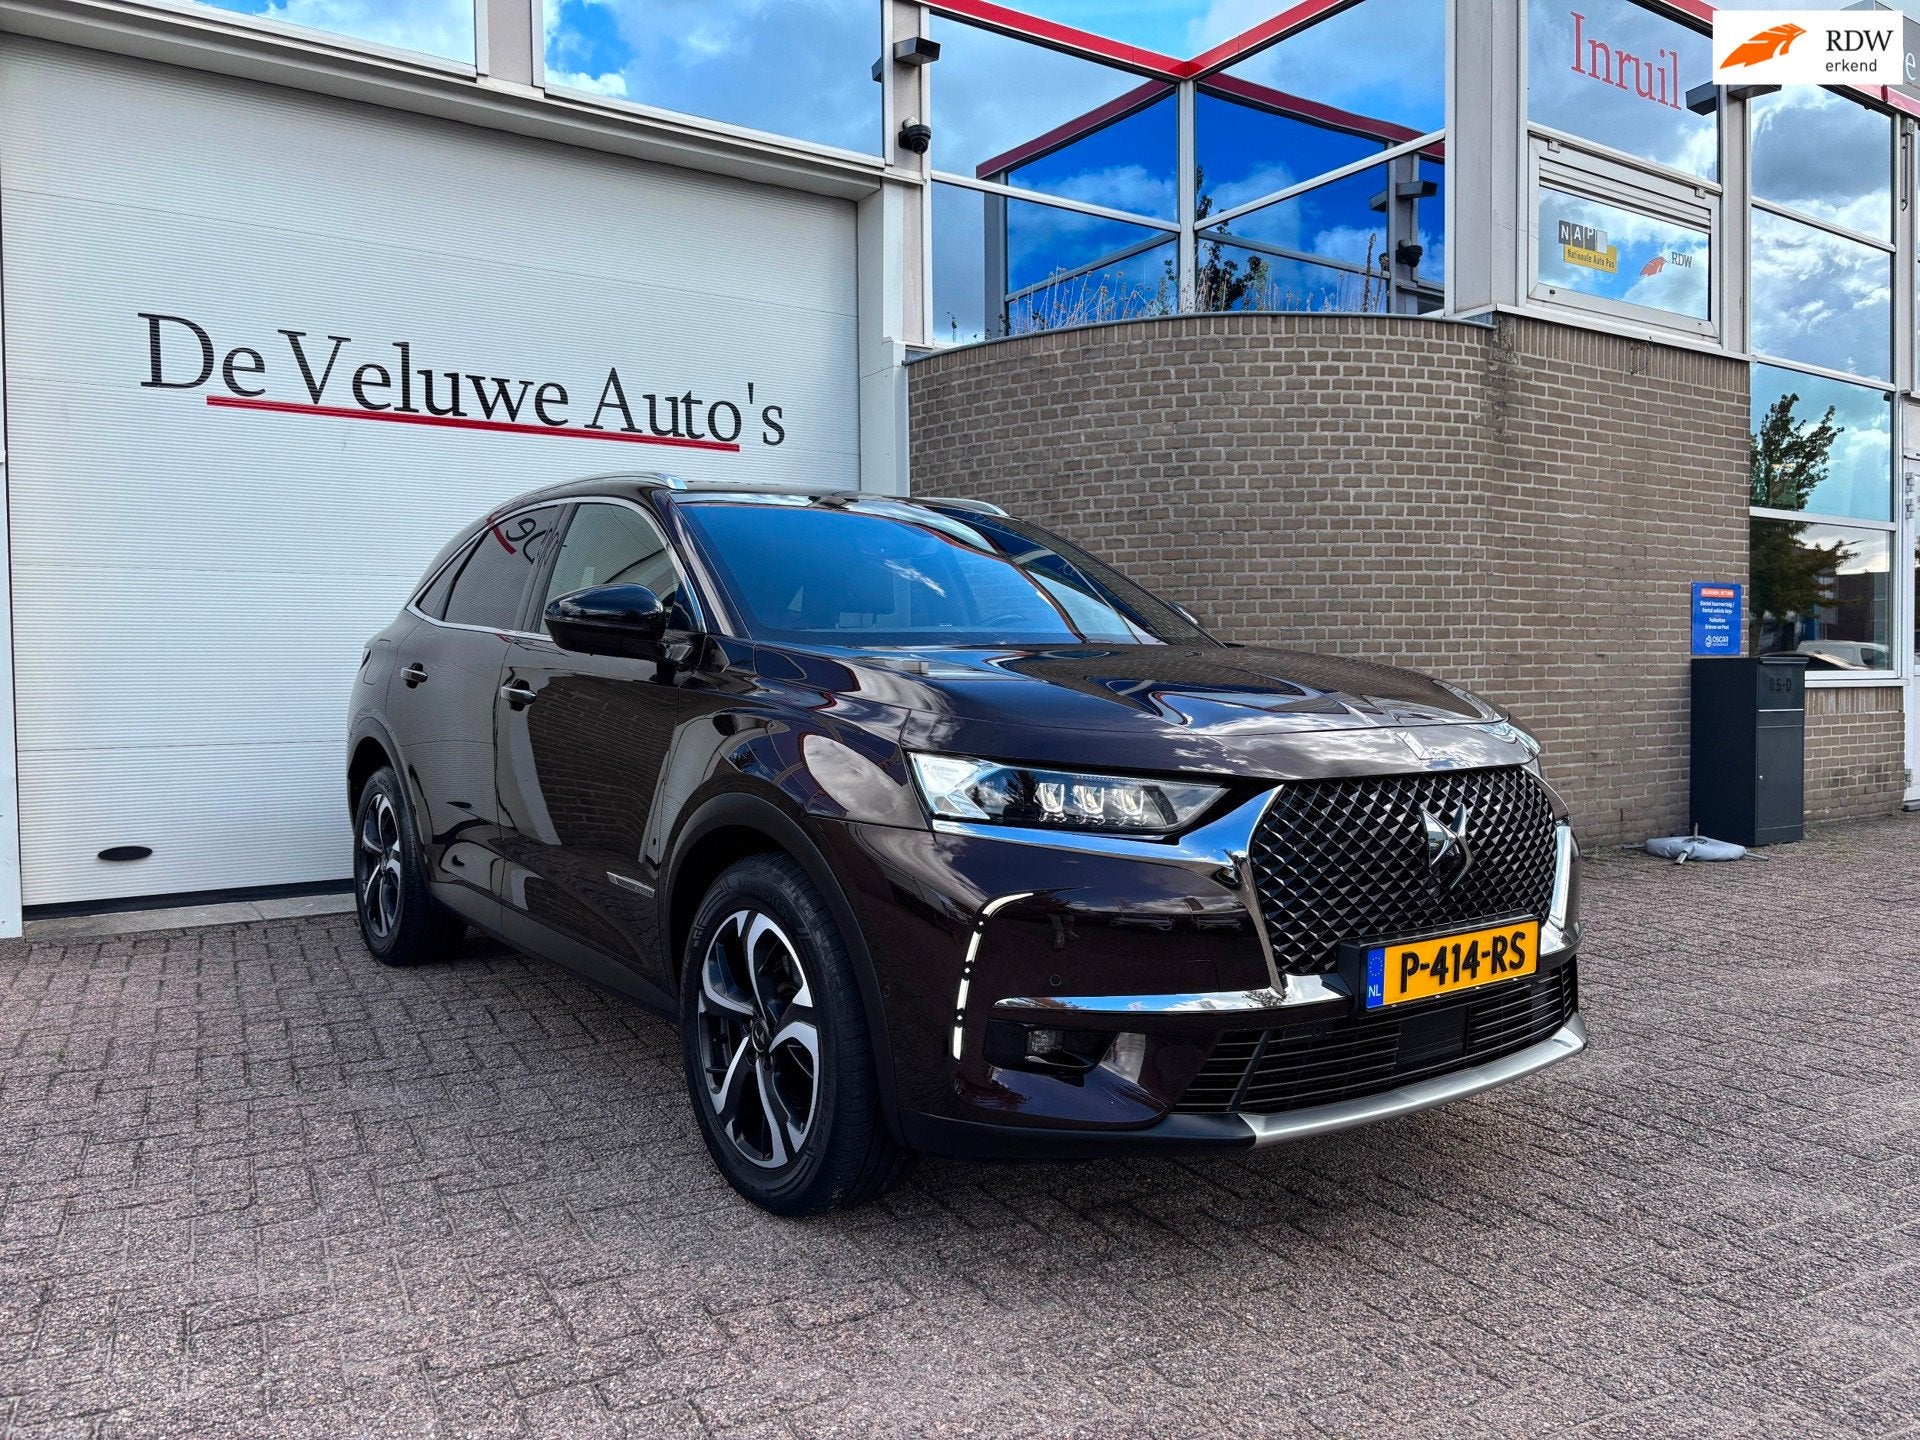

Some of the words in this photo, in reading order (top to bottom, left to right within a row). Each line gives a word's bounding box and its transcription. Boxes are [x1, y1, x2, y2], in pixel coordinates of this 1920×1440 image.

[1570, 11, 1682, 111] Inruil
[1561, 225, 1595, 241] NAP
[1567, 249, 1592, 264] Nationale
[1593, 255, 1605, 266] Auto
[1671, 251, 1693, 269] RDW
[137, 312, 267, 398] De
[277, 329, 570, 426] Veluwe
[584, 366, 786, 447] Auto's
[1712, 635, 1729, 643] OSCAR
[1400, 931, 1526, 994] P-414-RS
[1368, 984, 1382, 998] NL
